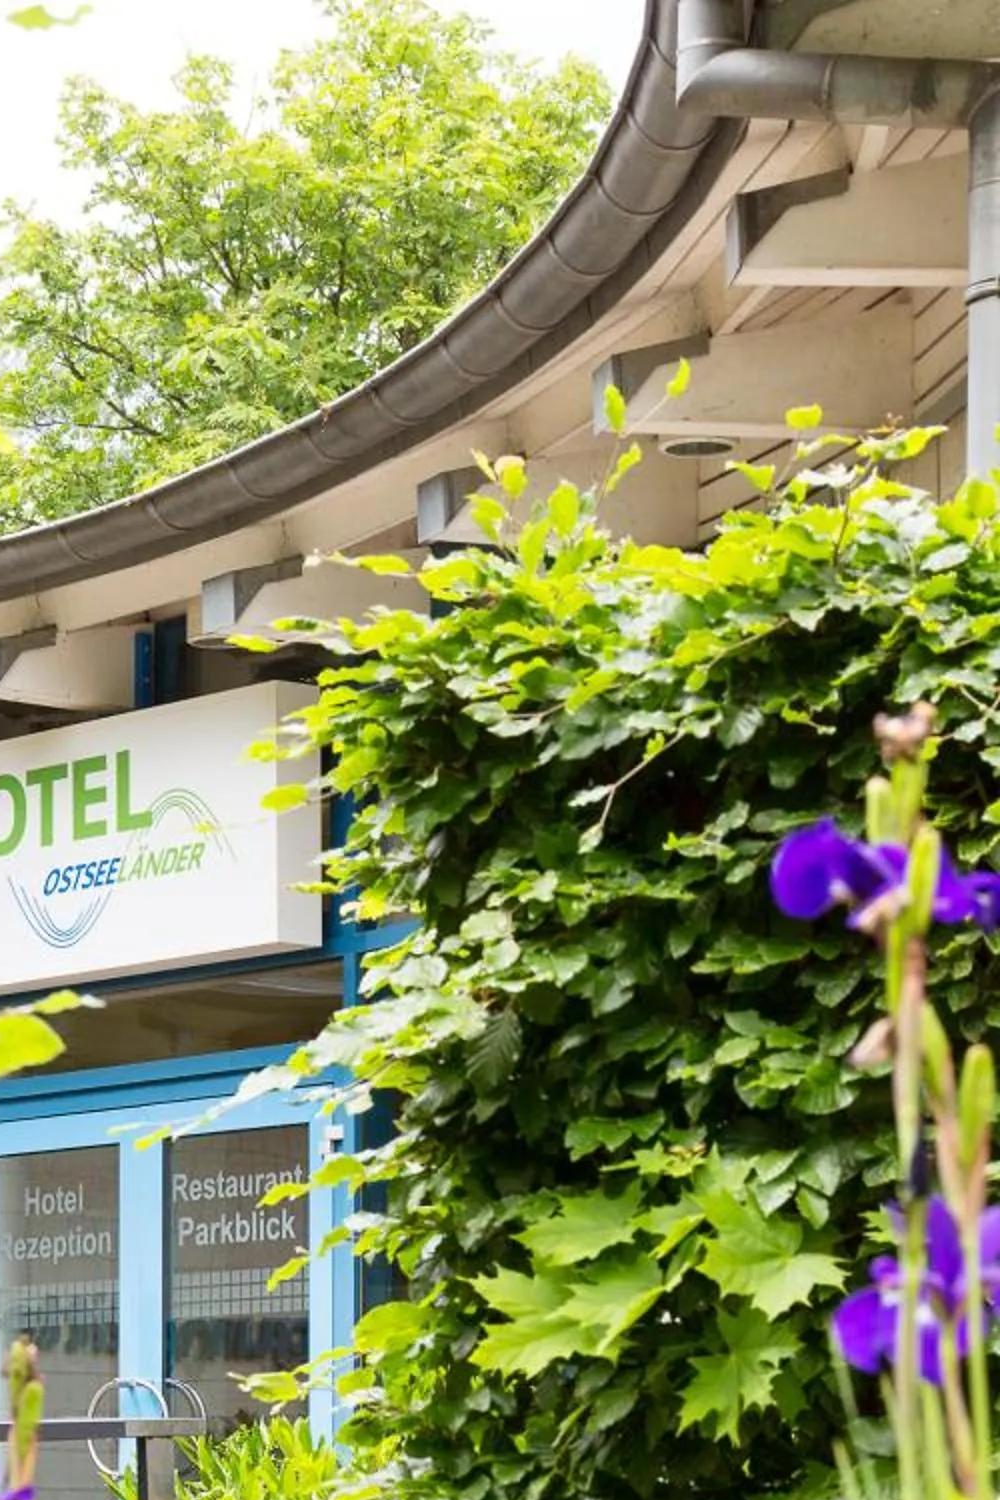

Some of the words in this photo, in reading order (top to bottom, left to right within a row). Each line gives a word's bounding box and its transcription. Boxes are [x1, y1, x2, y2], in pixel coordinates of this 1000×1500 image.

[43, 842, 206, 897] OSTSEELÄNDER
[24, 1183, 84, 1217] Hotel
[178, 1207, 297, 1247] Parkblick
